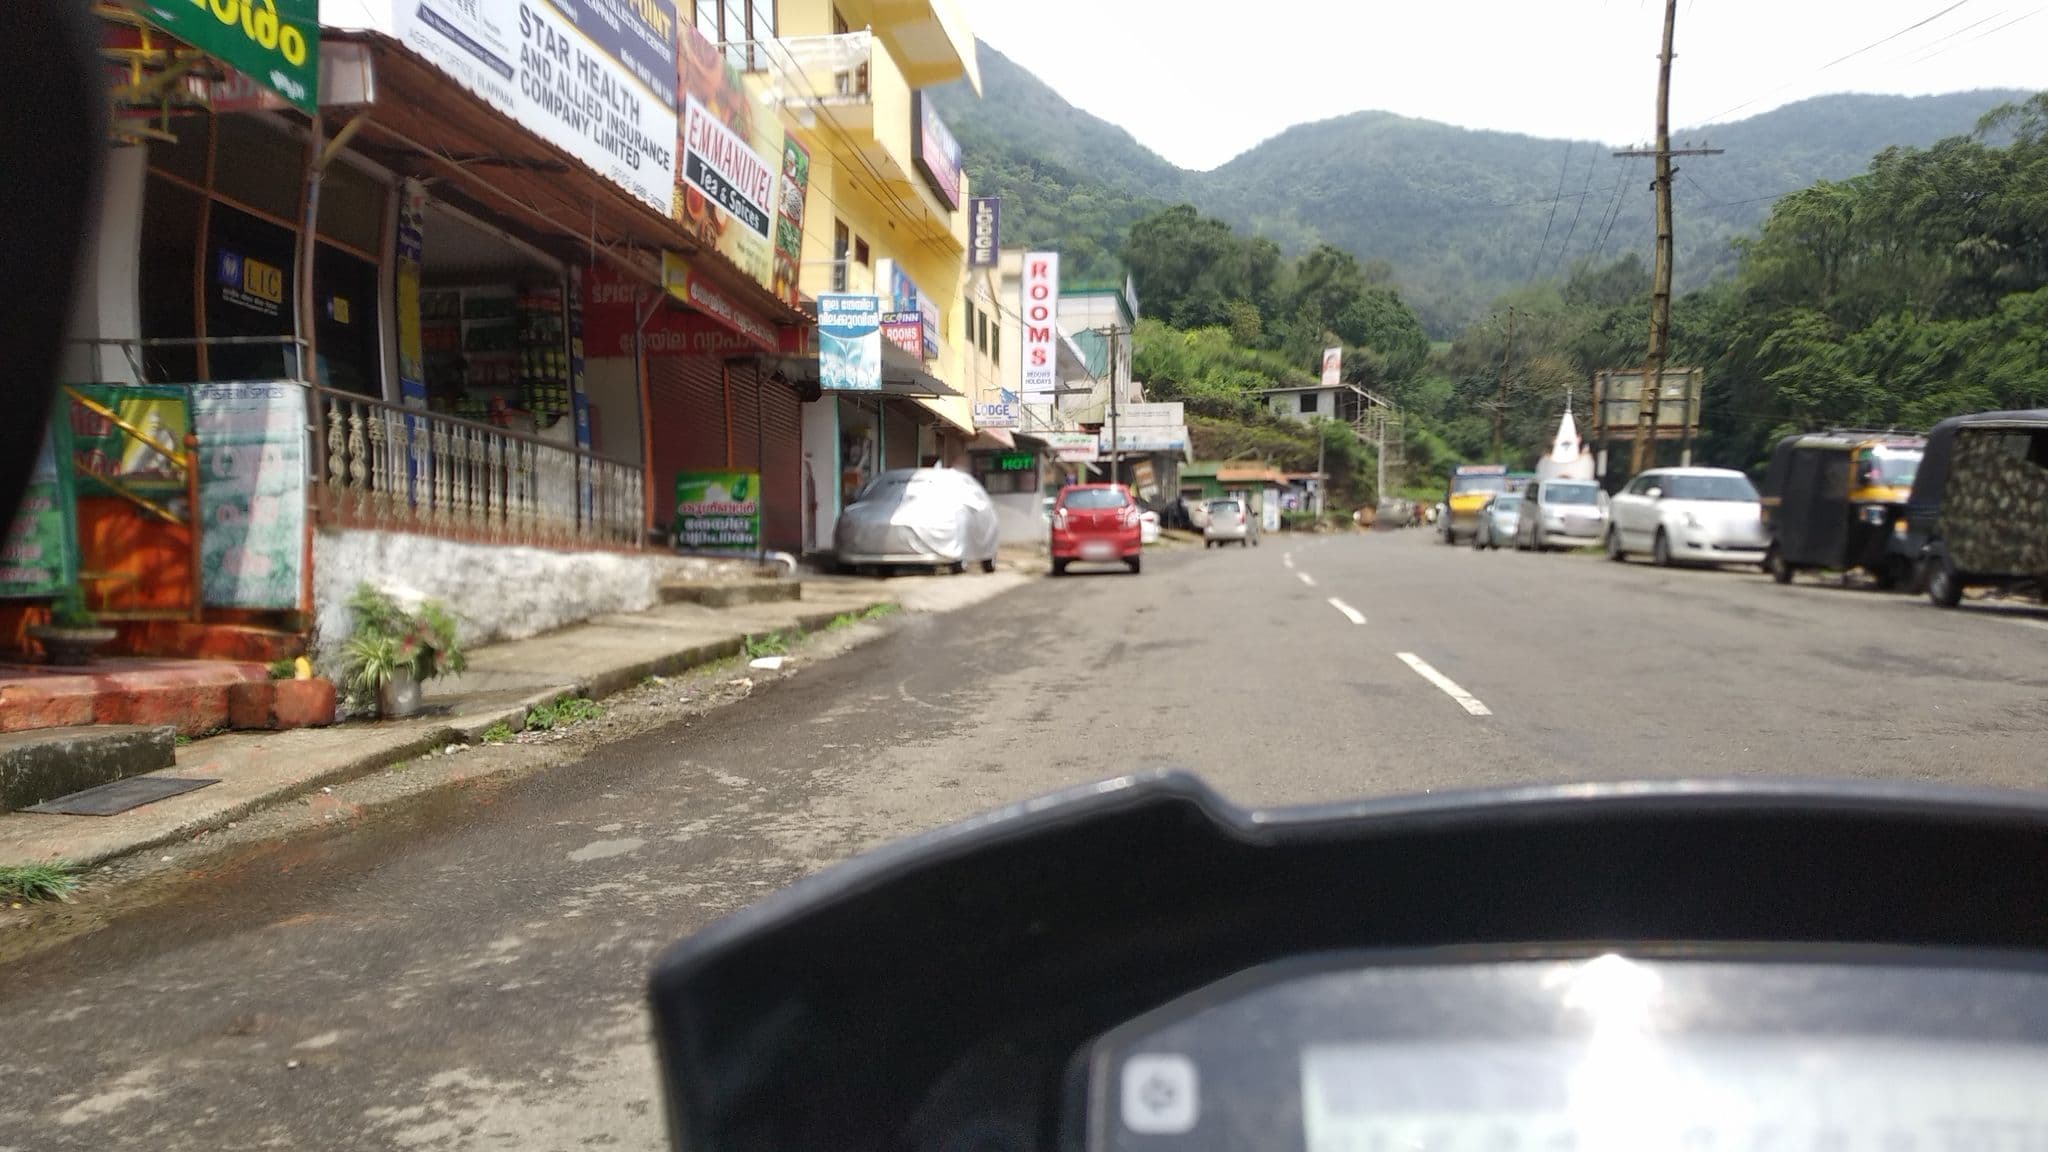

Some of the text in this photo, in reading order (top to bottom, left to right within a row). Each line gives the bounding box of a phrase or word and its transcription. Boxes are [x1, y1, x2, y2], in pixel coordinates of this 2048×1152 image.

[629, 0, 671, 45] OINT
[520, 4, 570, 70] STAR
[577, 49, 639, 125] HEALTH
[520, 70, 589, 137] COMPANY
[594, 123, 641, 171] LIMITED
[521, 42, 551, 82] AND
[557, 70, 602, 122] ALLIED
[607, 110, 670, 171] INSURANCE
[689, 105, 772, 214] EMMANUVEL
[699, 163, 719, 196] Tea
[720, 187, 728, 206] &
[729, 191, 760, 230] Spices
[974, 200, 993, 262] LODGE
[247, 264, 278, 297] LIC
[1029, 260, 1050, 367] ROOMS
[886, 327, 917, 341] ROOMS
[974, 404, 1010, 416] LODGE
